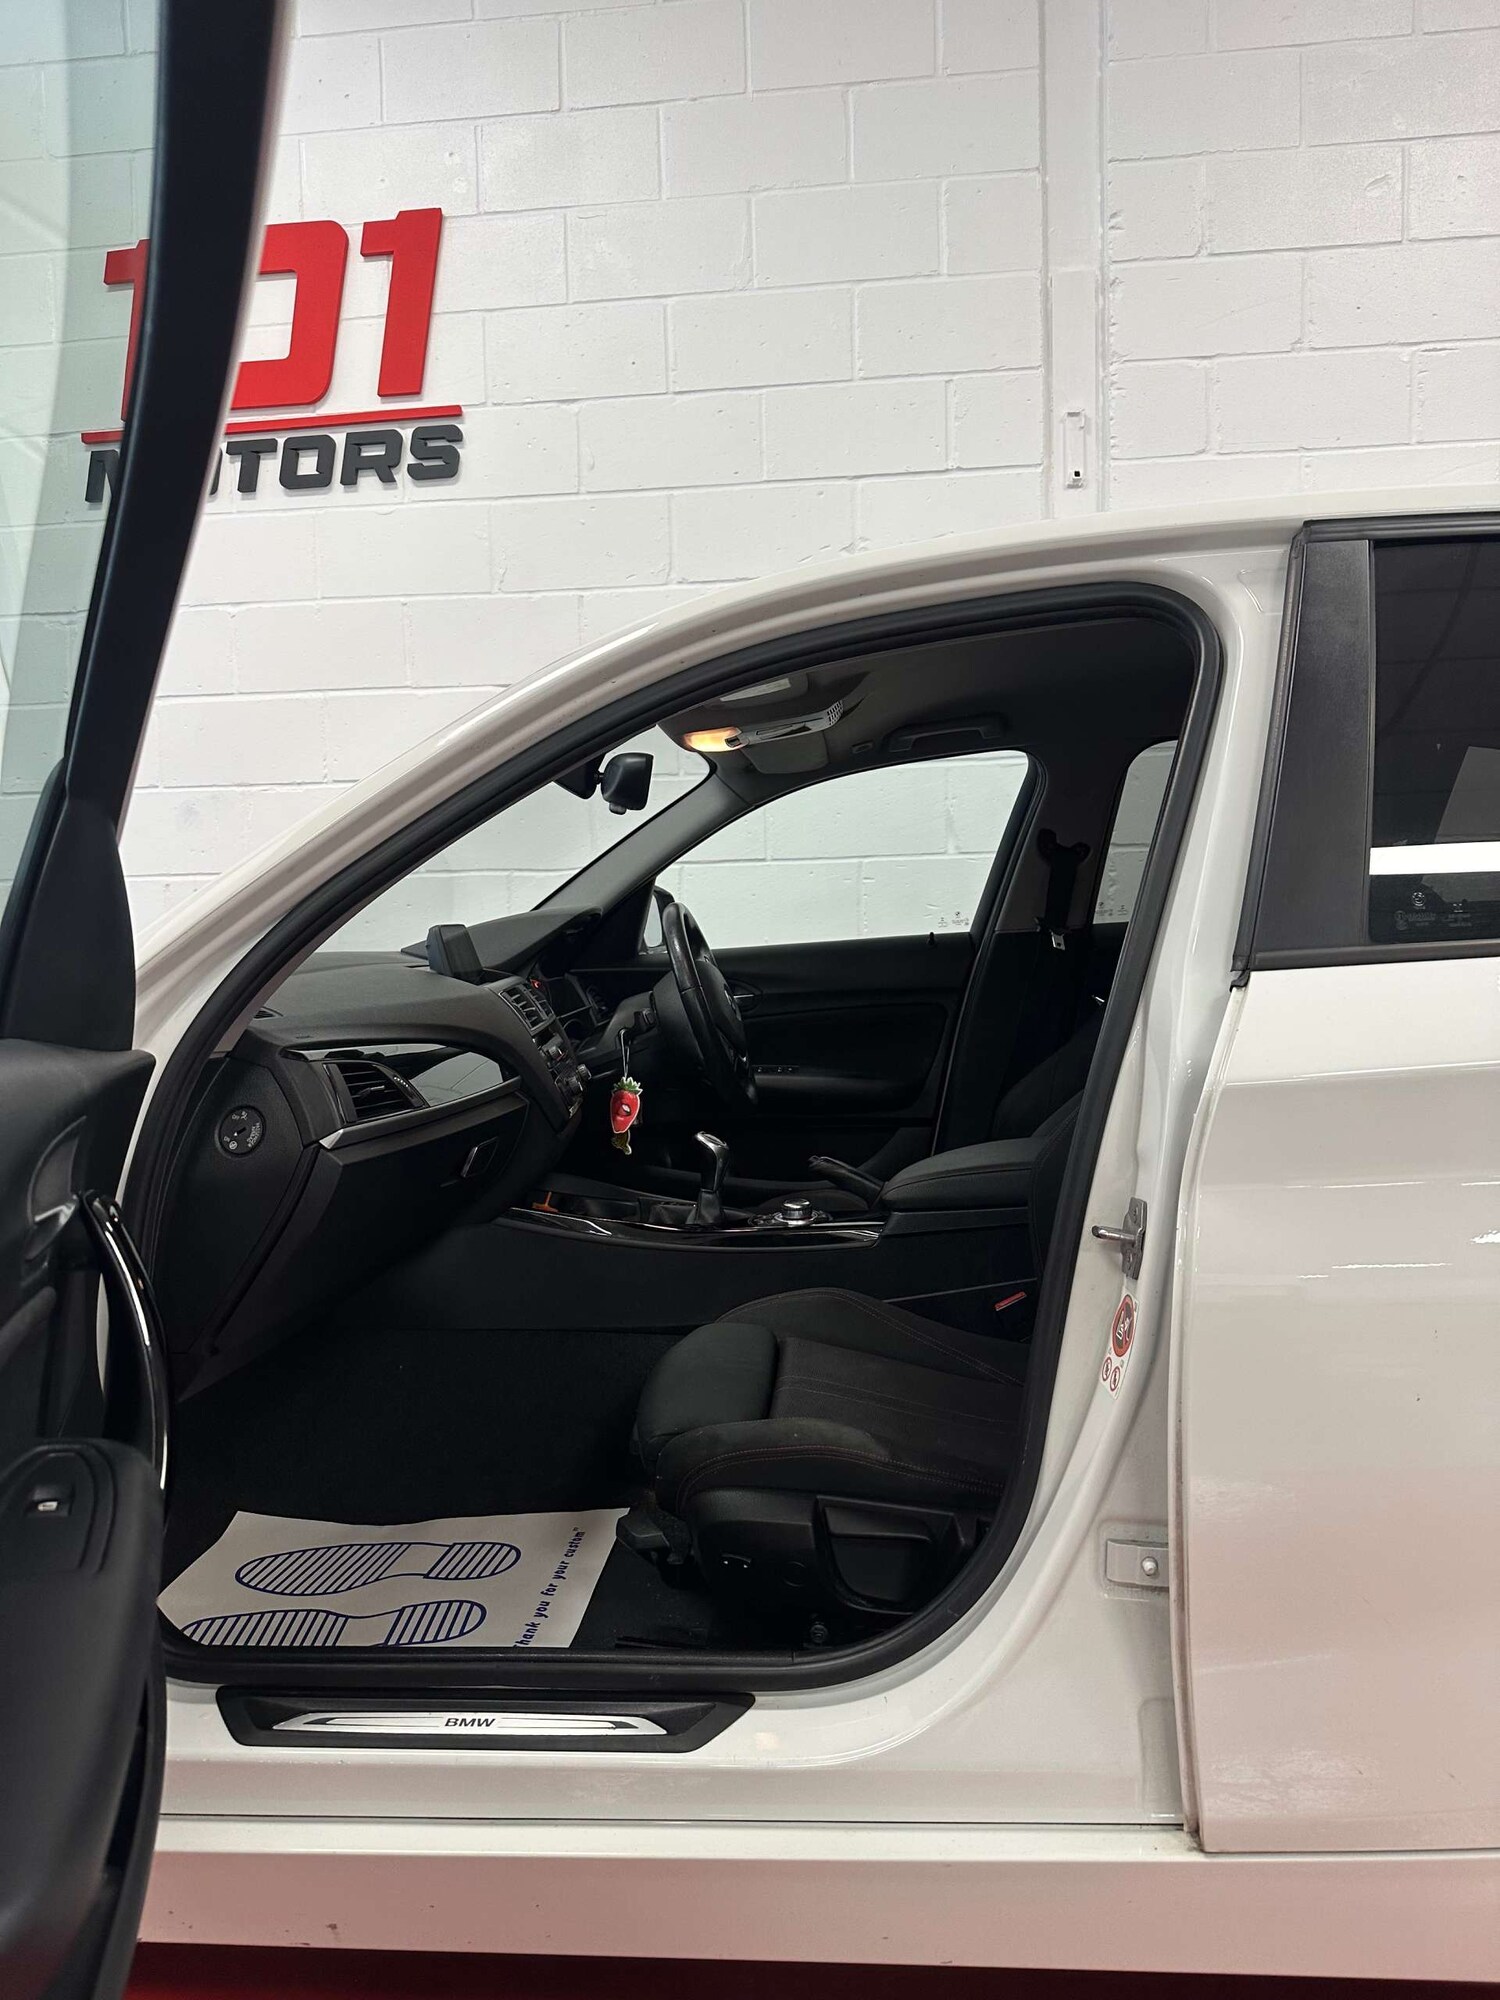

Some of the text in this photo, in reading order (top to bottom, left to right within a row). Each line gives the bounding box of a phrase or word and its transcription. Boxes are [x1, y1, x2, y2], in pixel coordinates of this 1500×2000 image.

[85, 424, 463, 502] TORS
[552, 1560, 570, 1580] your
[540, 1583, 558, 1596] for
[534, 1601, 551, 1619] you
[444, 1717, 496, 1727] BMW
